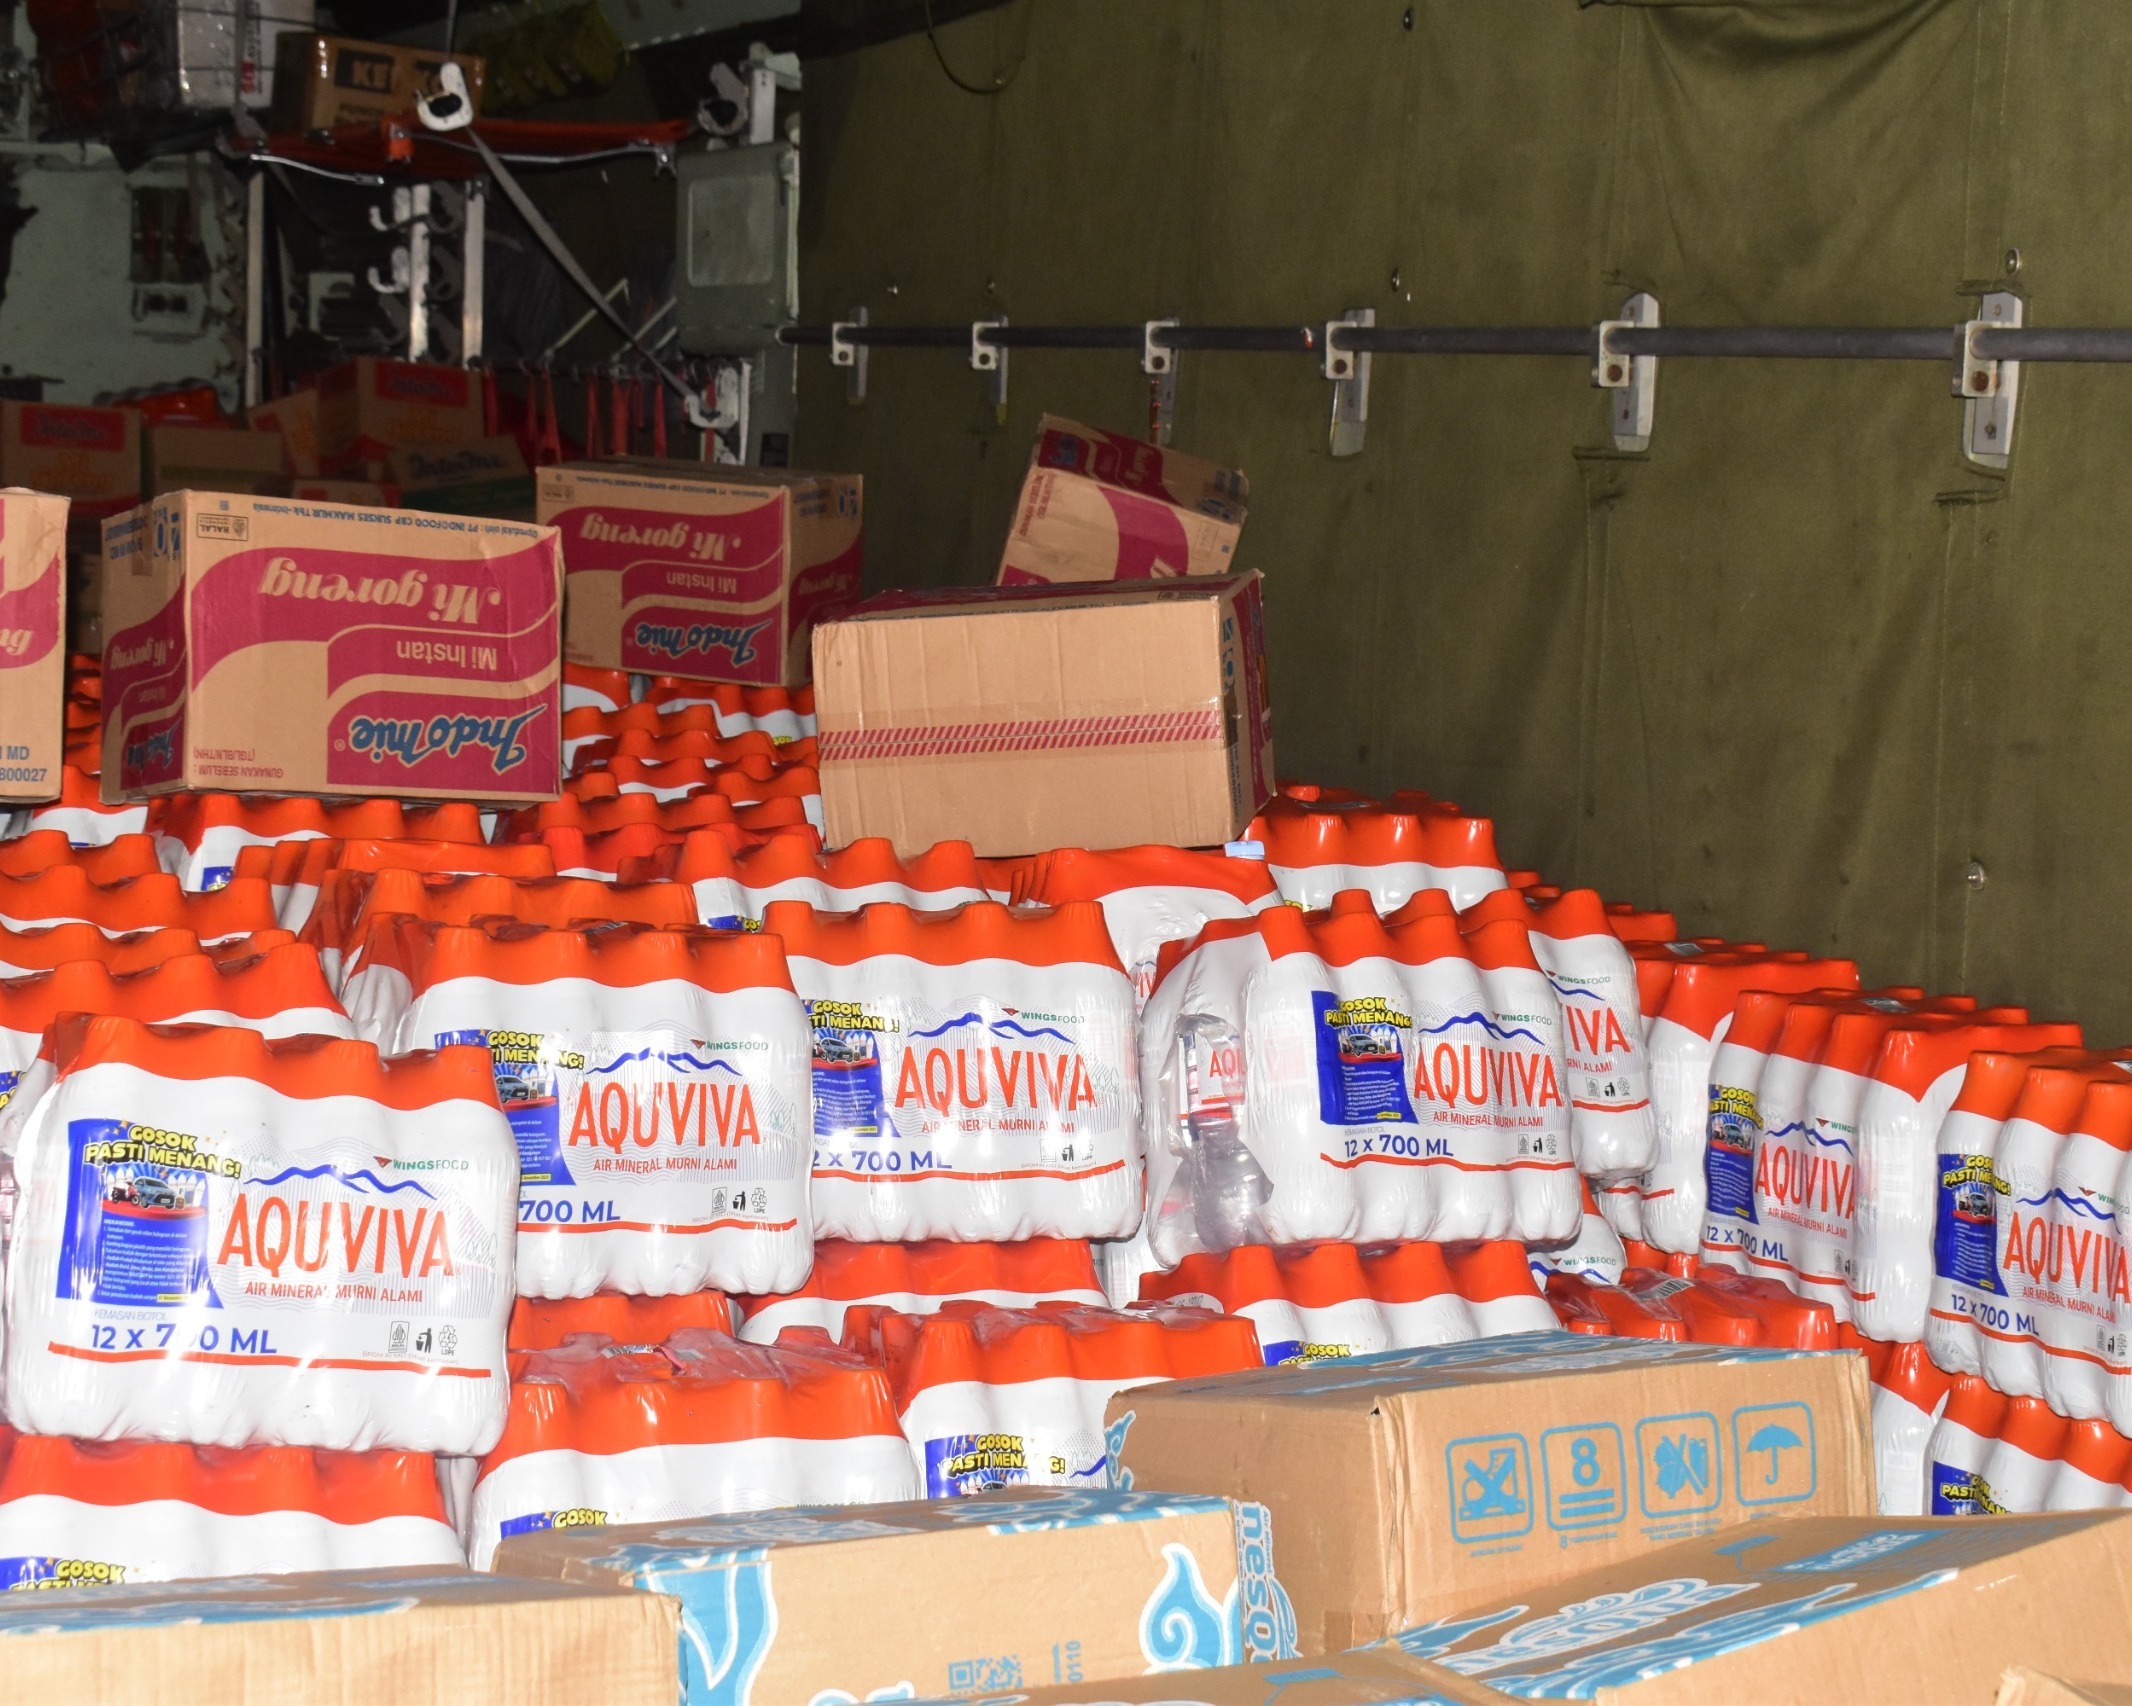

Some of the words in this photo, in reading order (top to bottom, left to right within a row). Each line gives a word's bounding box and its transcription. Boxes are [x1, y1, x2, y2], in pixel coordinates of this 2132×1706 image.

[314, 508, 355, 521] MAKMUR
[357, 511, 392, 523] SUKSES
[396, 515, 413, 526] CBP
[413, 516, 465, 531] INDOFOOD
[199, 524, 230, 535] HALAL
[465, 522, 478, 533] PT
[580, 513, 690, 548] goreng
[259, 556, 428, 607] goreng
[666, 571, 716, 590] Instan
[717, 577, 737, 594] Mi
[427, 582, 502, 624] Mi
[396, 640, 467, 669] Instan
[472, 646, 498, 671] Mi
[7, 745, 30, 761] MD
[249, 767, 285, 780] GUNAKAN
[812, 999, 863, 1017] GOSOK
[828, 1015, 901, 1034] MENAN!
[487, 1031, 545, 1050] GOSOK
[1413, 1040, 1567, 1110] AQUVIVA
[1566, 1057, 1582, 1070] RNI
[1583, 1060, 1613, 1074] ALAMI
[894, 1045, 1099, 1119] AQUVIVA
[567, 1080, 762, 1155] AQUVIVA
[921, 1120, 941, 1134] AIR
[998, 1118, 1035, 1132] MURNI
[1038, 1120, 1076, 1134] AMI
[1433, 1110, 1449, 1123] AIR
[1450, 1111, 1493, 1127] MINERAL
[1494, 1115, 1518, 1129] MURNI
[1518, 1115, 1545, 1128] ALAMI
[129, 1124, 199, 1152] GOSOK
[1344, 1138, 1358, 1158] 12
[1379, 1133, 1421, 1157] 700
[1426, 1138, 1455, 1158] ML
[84, 1139, 146, 1165] PASTI
[148, 1146, 242, 1180] MENANG!
[593, 1158, 612, 1171] AIR
[615, 1157, 662, 1174] MINERAL
[665, 1157, 701, 1169] MURNI
[703, 1157, 737, 1170] ALAMI
[811, 1151, 821, 1168] 2
[851, 1150, 903, 1172] 700
[910, 1150, 953, 1170] ML
[1942, 1168, 1978, 1189] PASTI
[519, 1199, 573, 1223] 700
[581, 1200, 622, 1223] ML
[1768, 1206, 1780, 1218] AIR
[1803, 1217, 1825, 1233] MURNI
[216, 1192, 454, 1279] AQUVIVA
[1706, 1225, 1719, 1242] 12
[1736, 1227, 1758, 1255] 700
[1761, 1238, 1789, 1262] ML
[2002, 1211, 2132, 1305] AQUVIVA
[245, 1280, 269, 1296] AIR
[270, 1282, 323, 1300] MINERA
[336, 1284, 377, 1301] MURNI
[379, 1287, 424, 1304] ALAMI
[2022, 1286, 2035, 1299] AIR
[2067, 1297, 2095, 1315] MURNI
[1951, 1293, 1968, 1314] 12
[1979, 1303, 2011, 1331] 700
[2015, 1312, 2040, 1337] ML
[91, 1324, 117, 1350] 12
[155, 1323, 220, 1351] 70
[231, 1327, 278, 1355] ML
[1303, 1343, 1352, 1358] GOSOK
[441, 1348, 455, 1357] LDPE
[976, 1433, 1024, 1453] GOSOK
[941, 1451, 990, 1476] PASTI
[1570, 1436, 1601, 1488] 8
[553, 1508, 609, 1529] GOSOK
[55, 1559, 127, 1585] GOSOK
